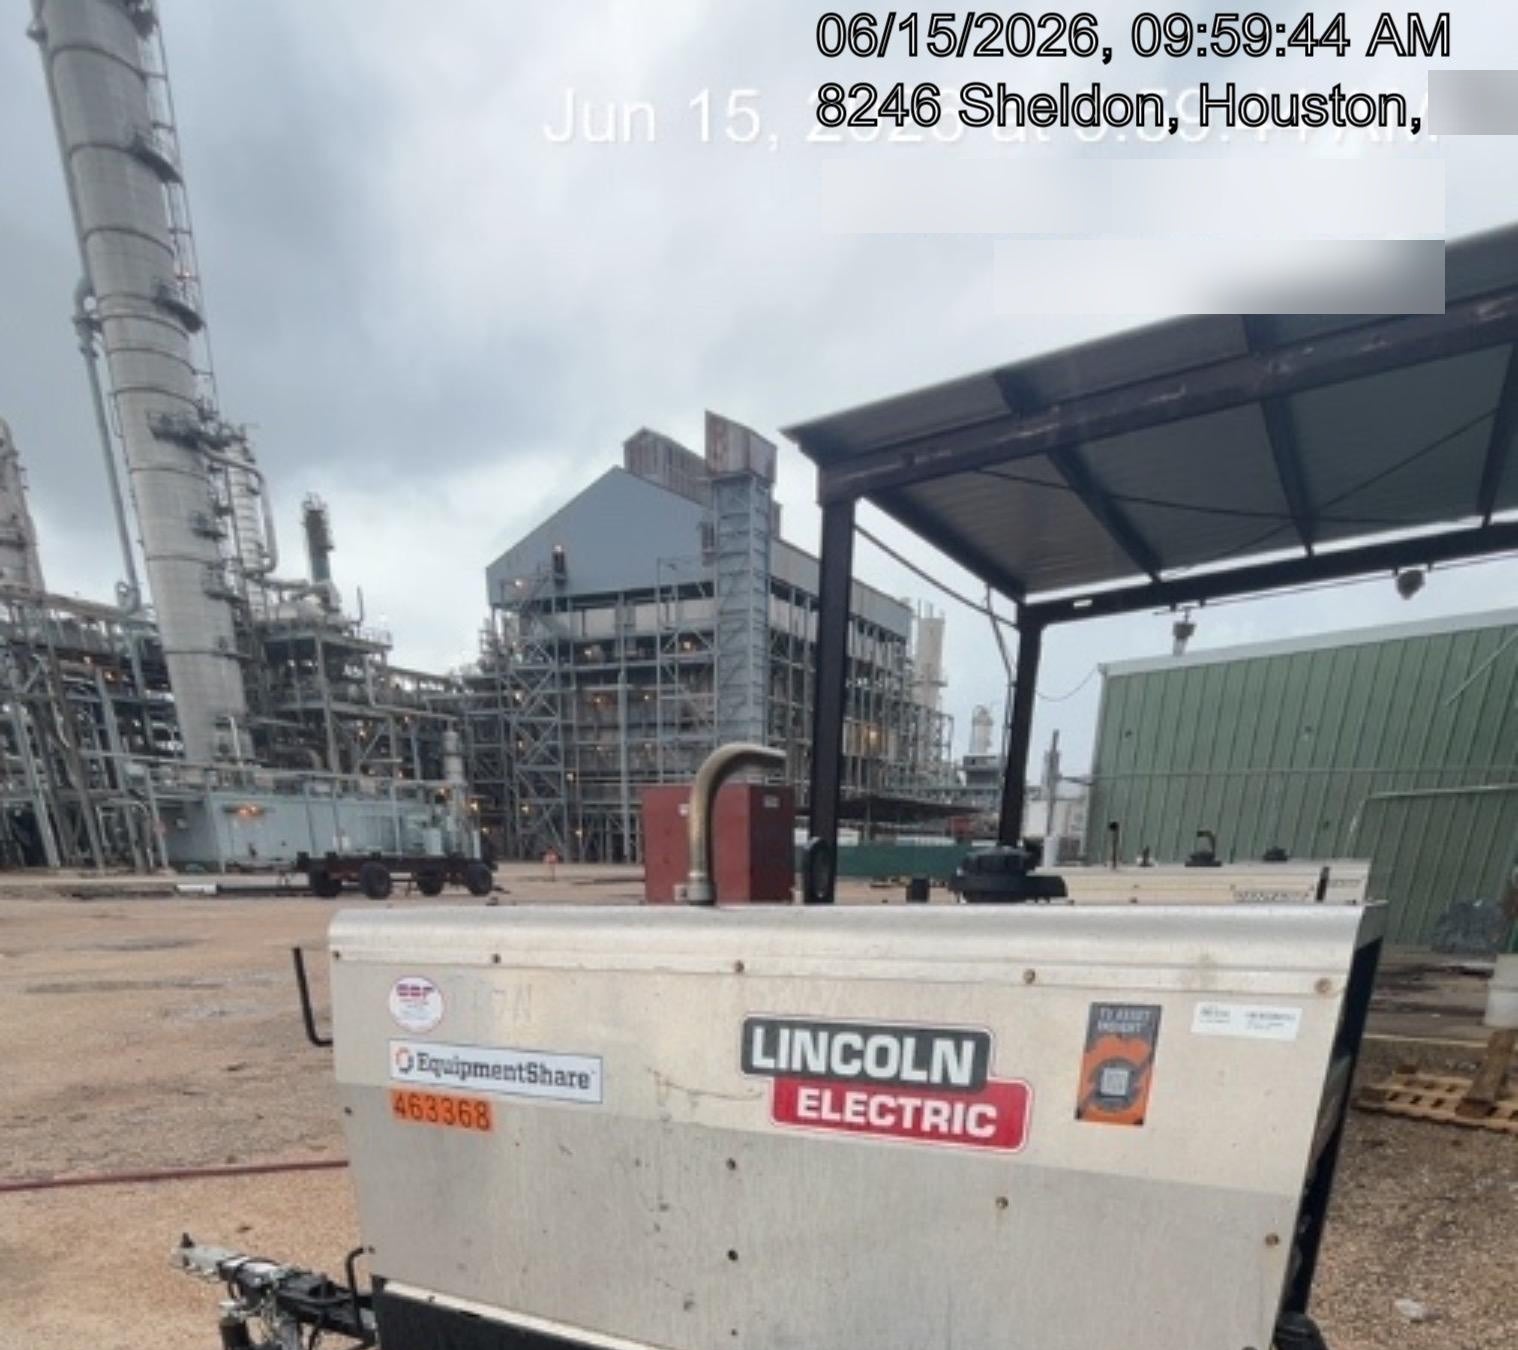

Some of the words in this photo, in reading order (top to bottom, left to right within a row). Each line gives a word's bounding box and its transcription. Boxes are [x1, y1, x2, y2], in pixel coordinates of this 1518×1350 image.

[416, 1052, 592, 1090] EquipmentShare
[752, 1026, 976, 1086] LINCOLN
[393, 1092, 491, 1131] 463368
[796, 1087, 998, 1138] ELECTRIC
